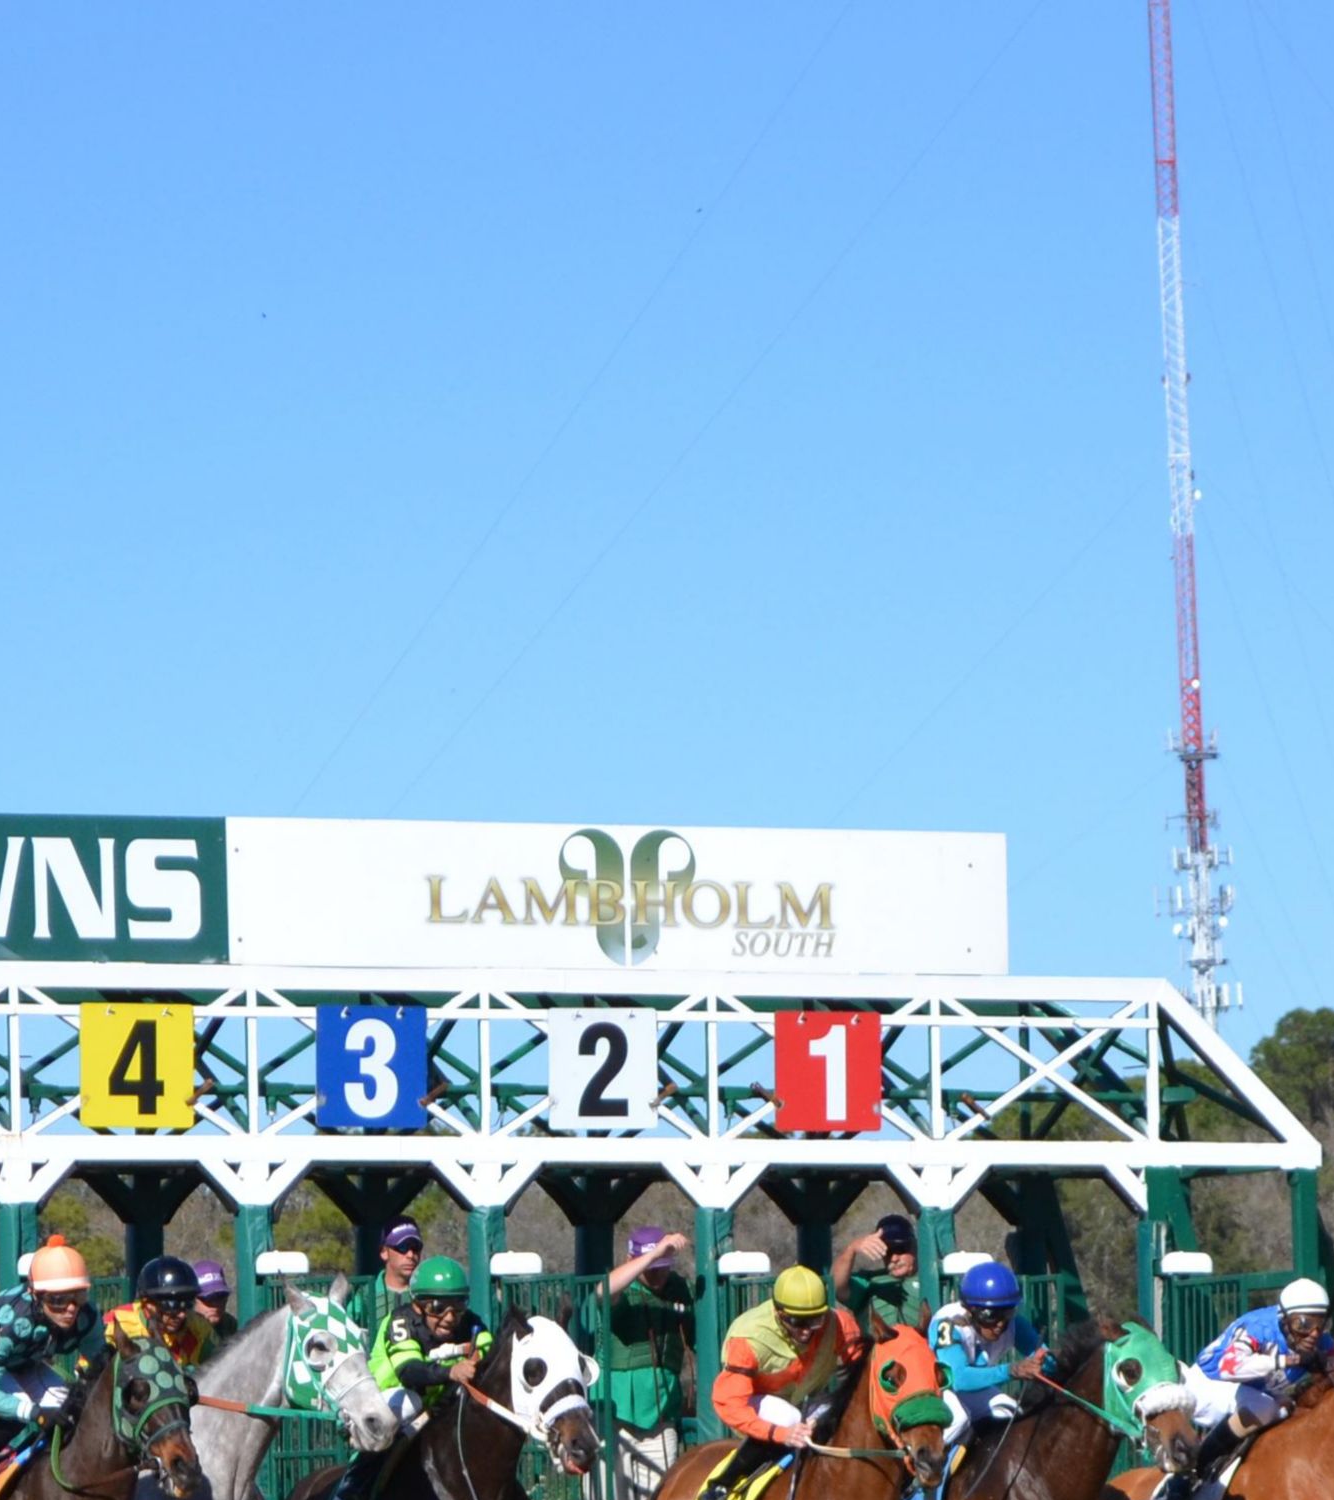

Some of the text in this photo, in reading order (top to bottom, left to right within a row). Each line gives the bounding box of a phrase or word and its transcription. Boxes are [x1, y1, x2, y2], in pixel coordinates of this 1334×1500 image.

[426, 874, 835, 930] LAMBHOLM
[732, 932, 836, 958] SOUTH
[108, 1020, 165, 1115] 4
[344, 1018, 398, 1118] 3
[577, 1022, 628, 1117] 2
[809, 1024, 847, 1121] 1
[392, 1318, 407, 1341] 5
[938, 1321, 951, 1345] 3
